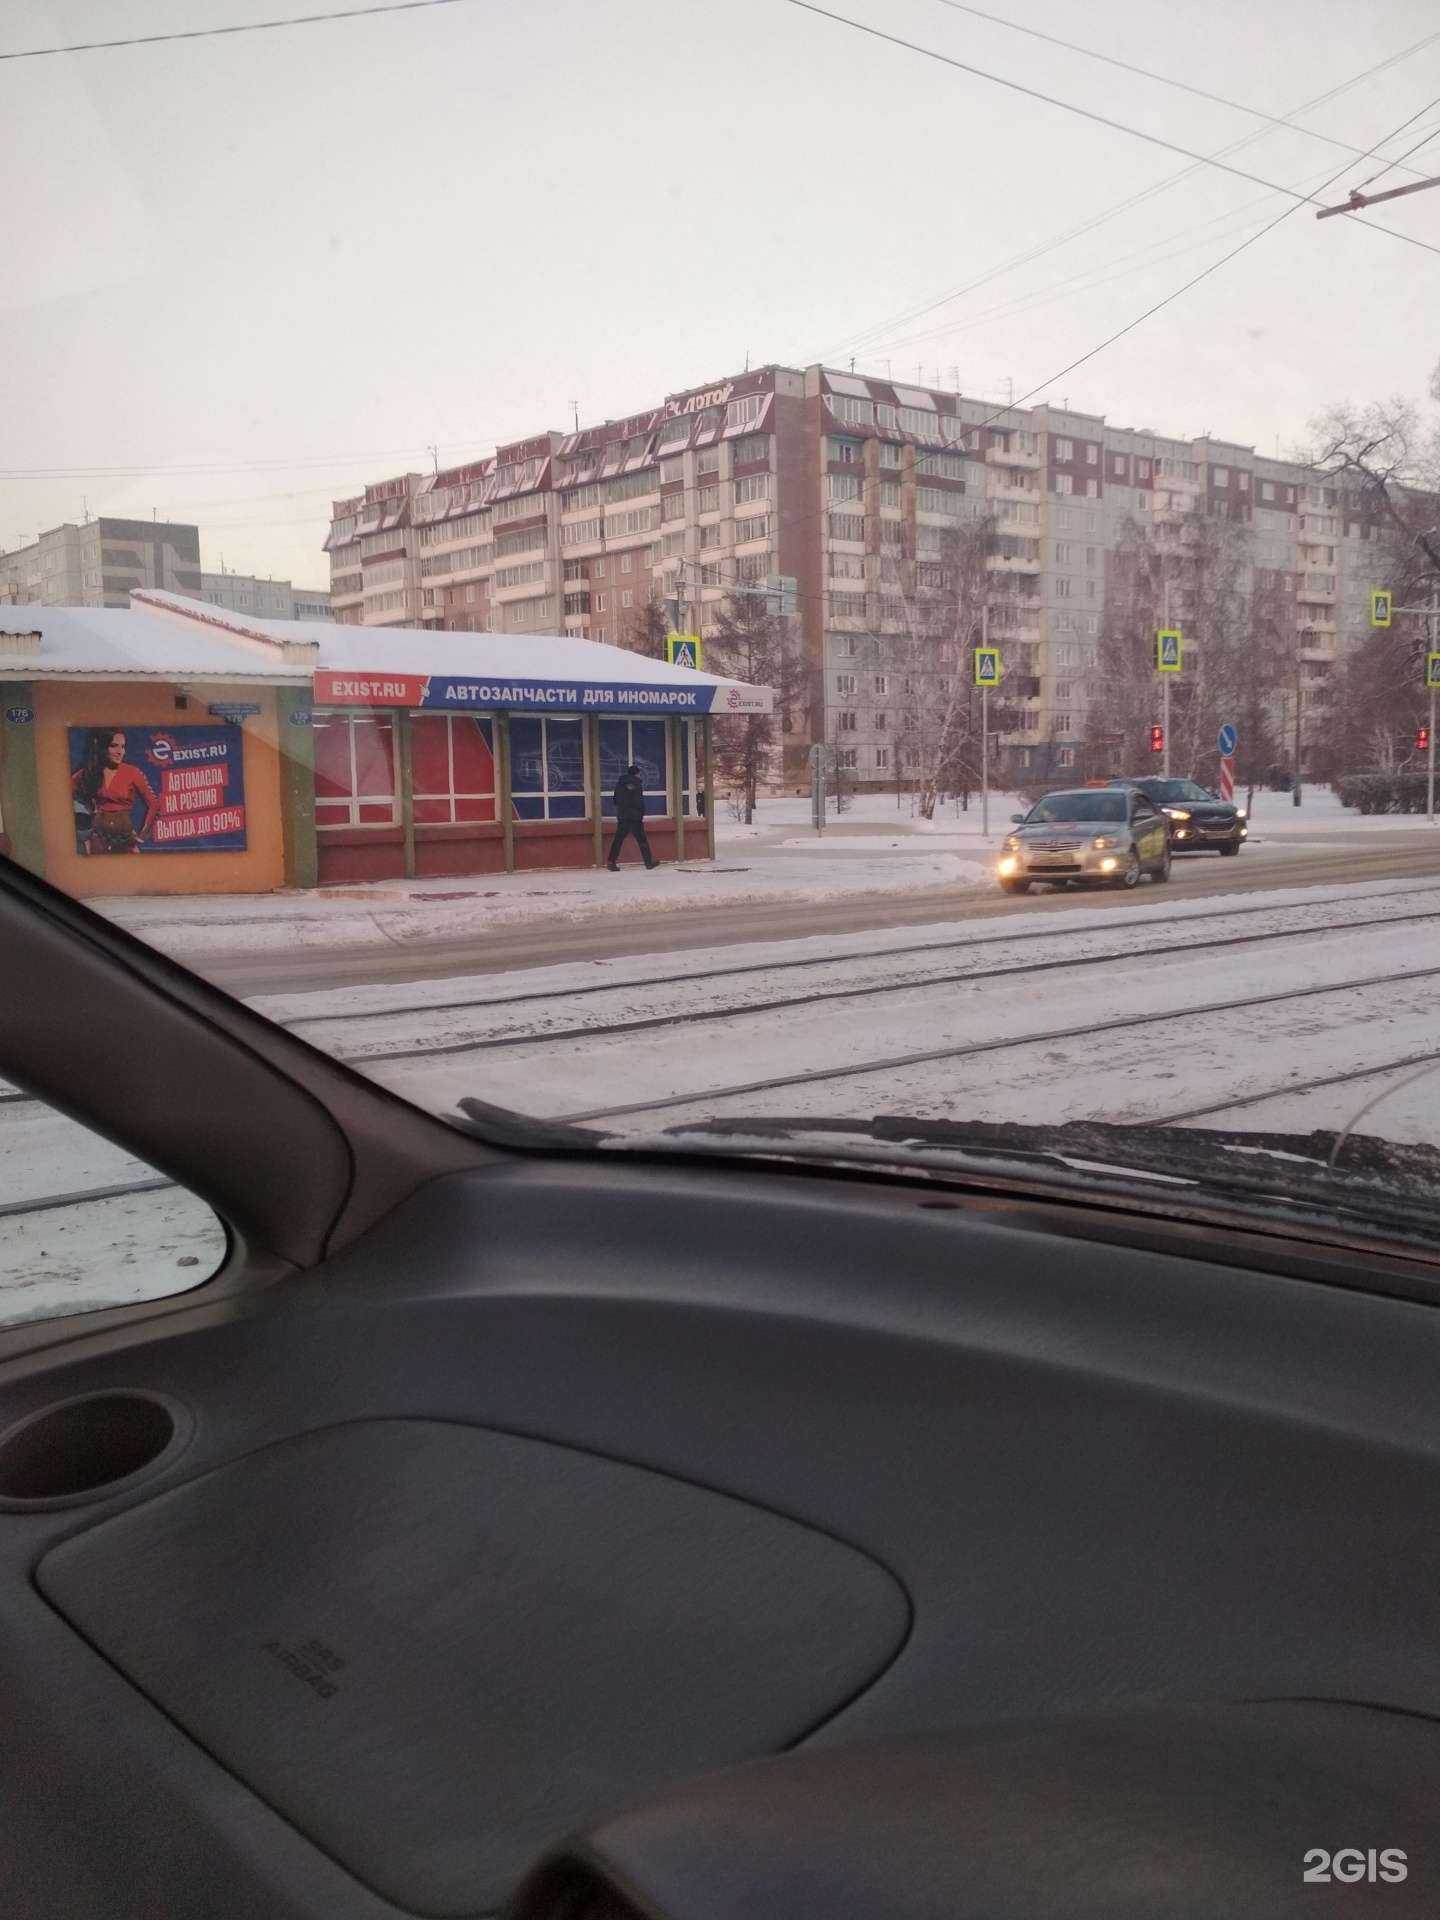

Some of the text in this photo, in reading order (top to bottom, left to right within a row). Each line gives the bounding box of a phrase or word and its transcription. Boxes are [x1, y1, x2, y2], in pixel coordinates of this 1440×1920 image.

[332, 680, 406, 697] EXIST.RU
[445, 685, 696, 706] АВТОЗАПЧАСТИ ДЛЯ ИНОМАРОК
[173, 744, 227, 760] EXIST.RU
[165, 788, 217, 813] НА РОЗЛИВ
[156, 811, 240, 839] ВЫГОДА ДО 90%
